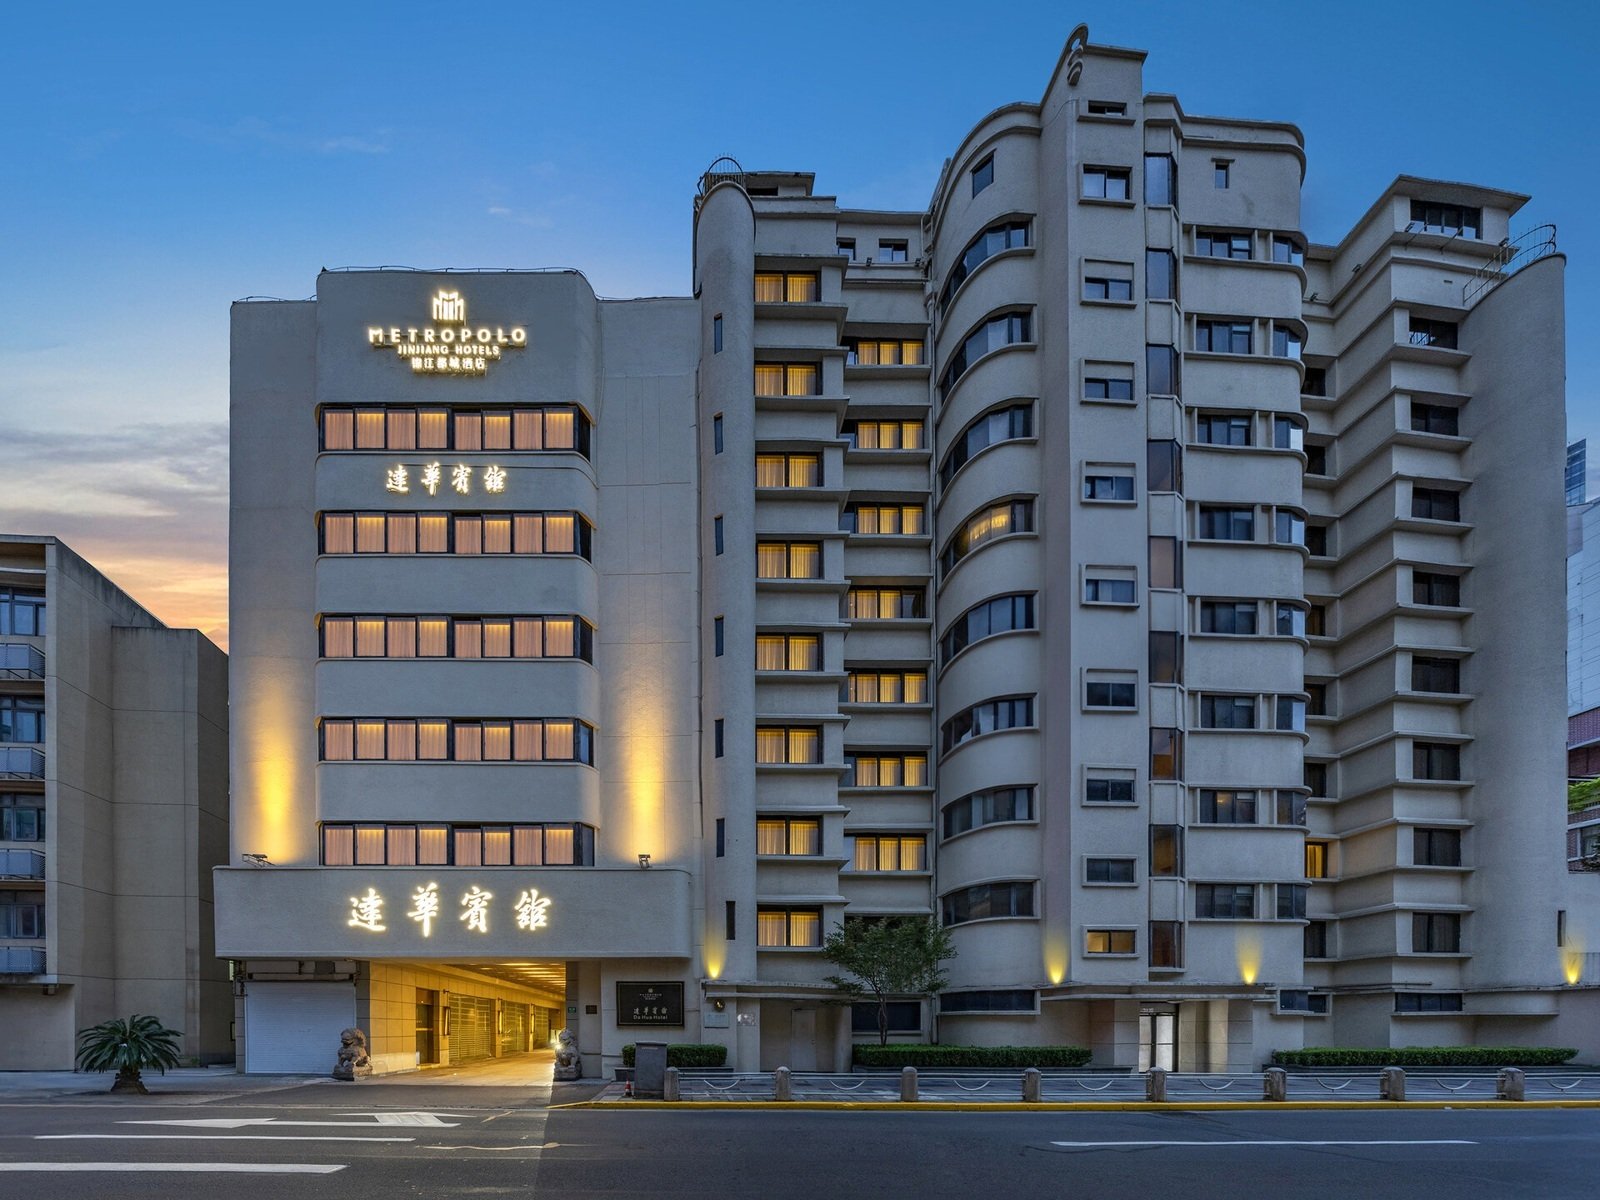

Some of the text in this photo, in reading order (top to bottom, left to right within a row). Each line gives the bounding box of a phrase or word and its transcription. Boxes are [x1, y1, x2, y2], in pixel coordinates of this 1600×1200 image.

[368, 328, 526, 343] METROPOLO
[398, 345, 500, 355] JINJIANG HOTELS
